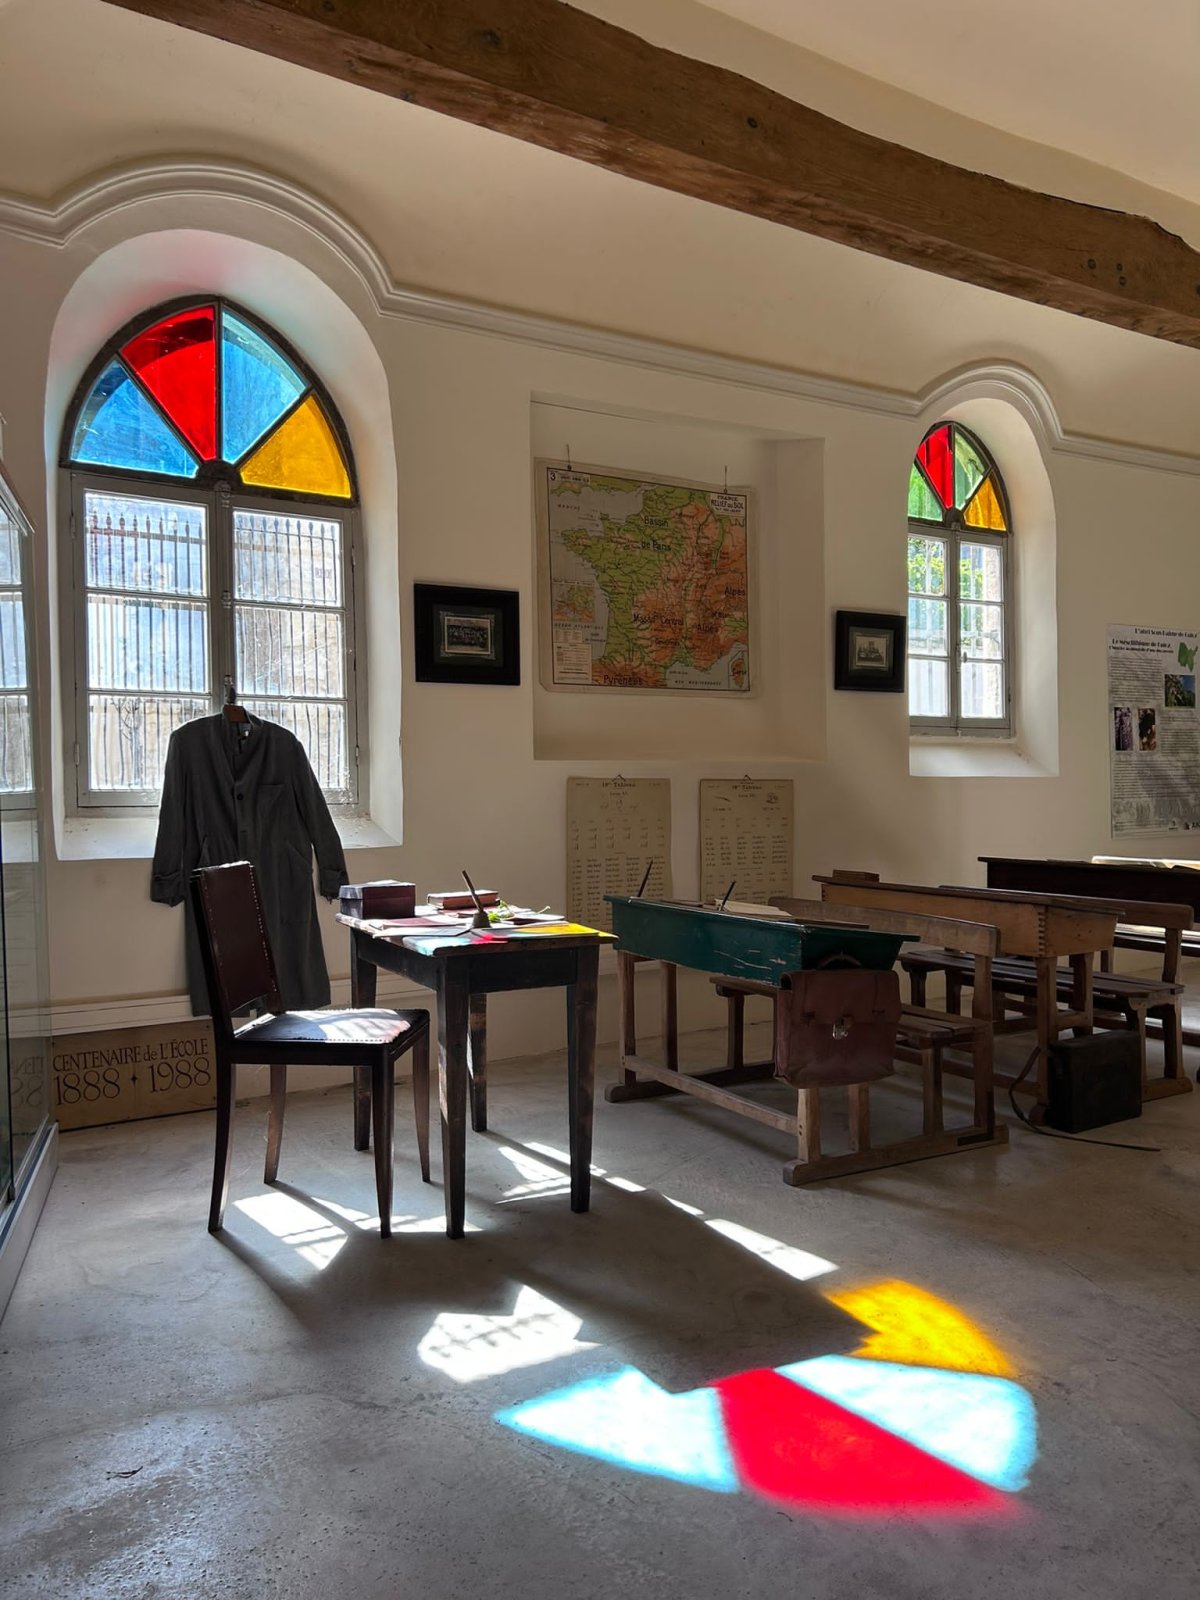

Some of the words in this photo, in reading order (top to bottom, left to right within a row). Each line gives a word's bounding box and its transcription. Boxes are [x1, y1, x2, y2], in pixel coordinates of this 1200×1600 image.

[550, 472, 556, 481] 3
[734, 501, 744, 510] SOL
[644, 515, 669, 528] Bassin
[641, 541, 651, 549] de
[653, 539, 672, 551] Paris
[725, 586, 746, 596] Alpes
[633, 611, 658, 624] Massif
[661, 615, 684, 626] Central
[696, 624, 719, 635] Alpes
[53, 1045, 143, 1072] CENTENAIRE
[143, 1047, 158, 1061] de
[159, 1038, 209, 1060] L'ÉCOLE
[54, 1067, 121, 1106] 1888
[149, 1057, 211, 1093] 1988
